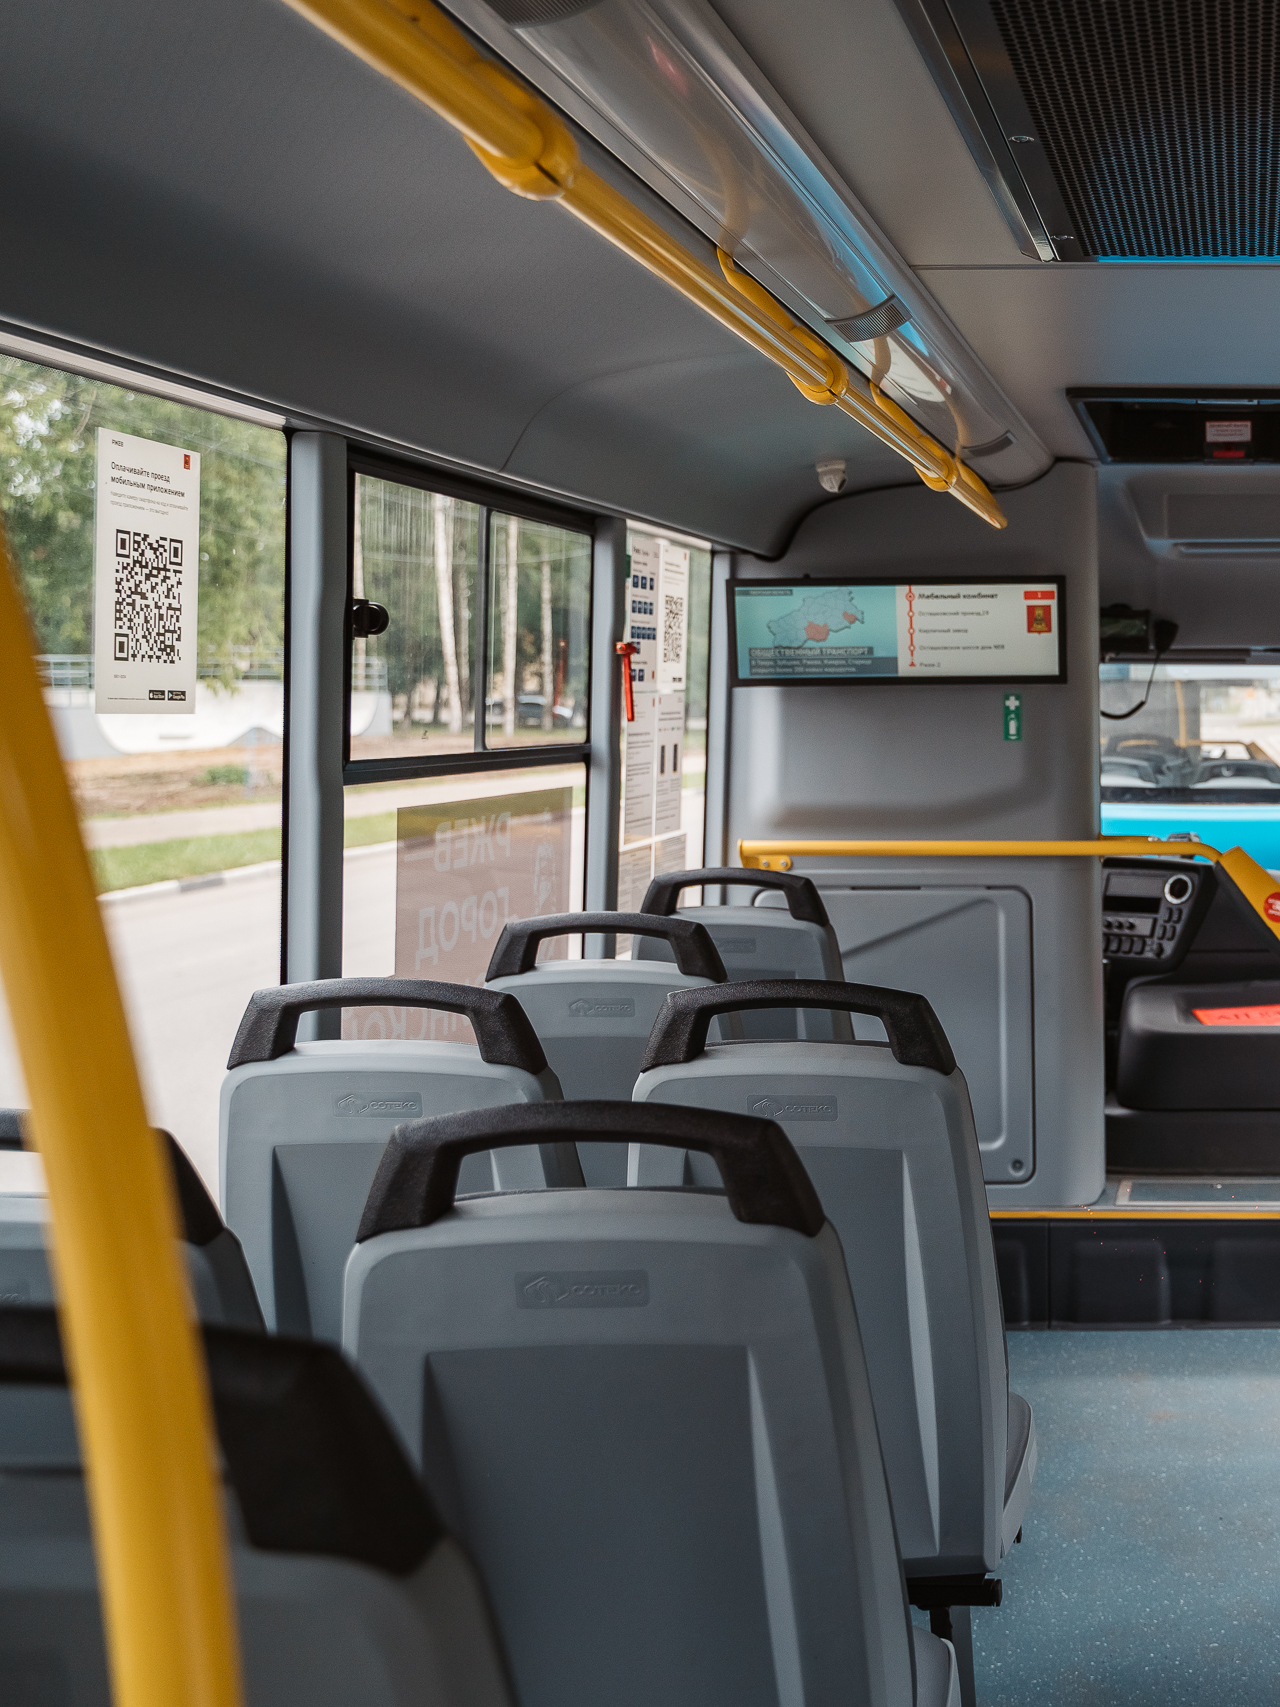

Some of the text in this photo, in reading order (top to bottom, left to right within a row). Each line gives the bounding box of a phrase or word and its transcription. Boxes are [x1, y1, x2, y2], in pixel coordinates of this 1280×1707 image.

[111, 461, 171, 484] Оплачивайте проезд
[111, 476, 185, 498] мобильным приложением
